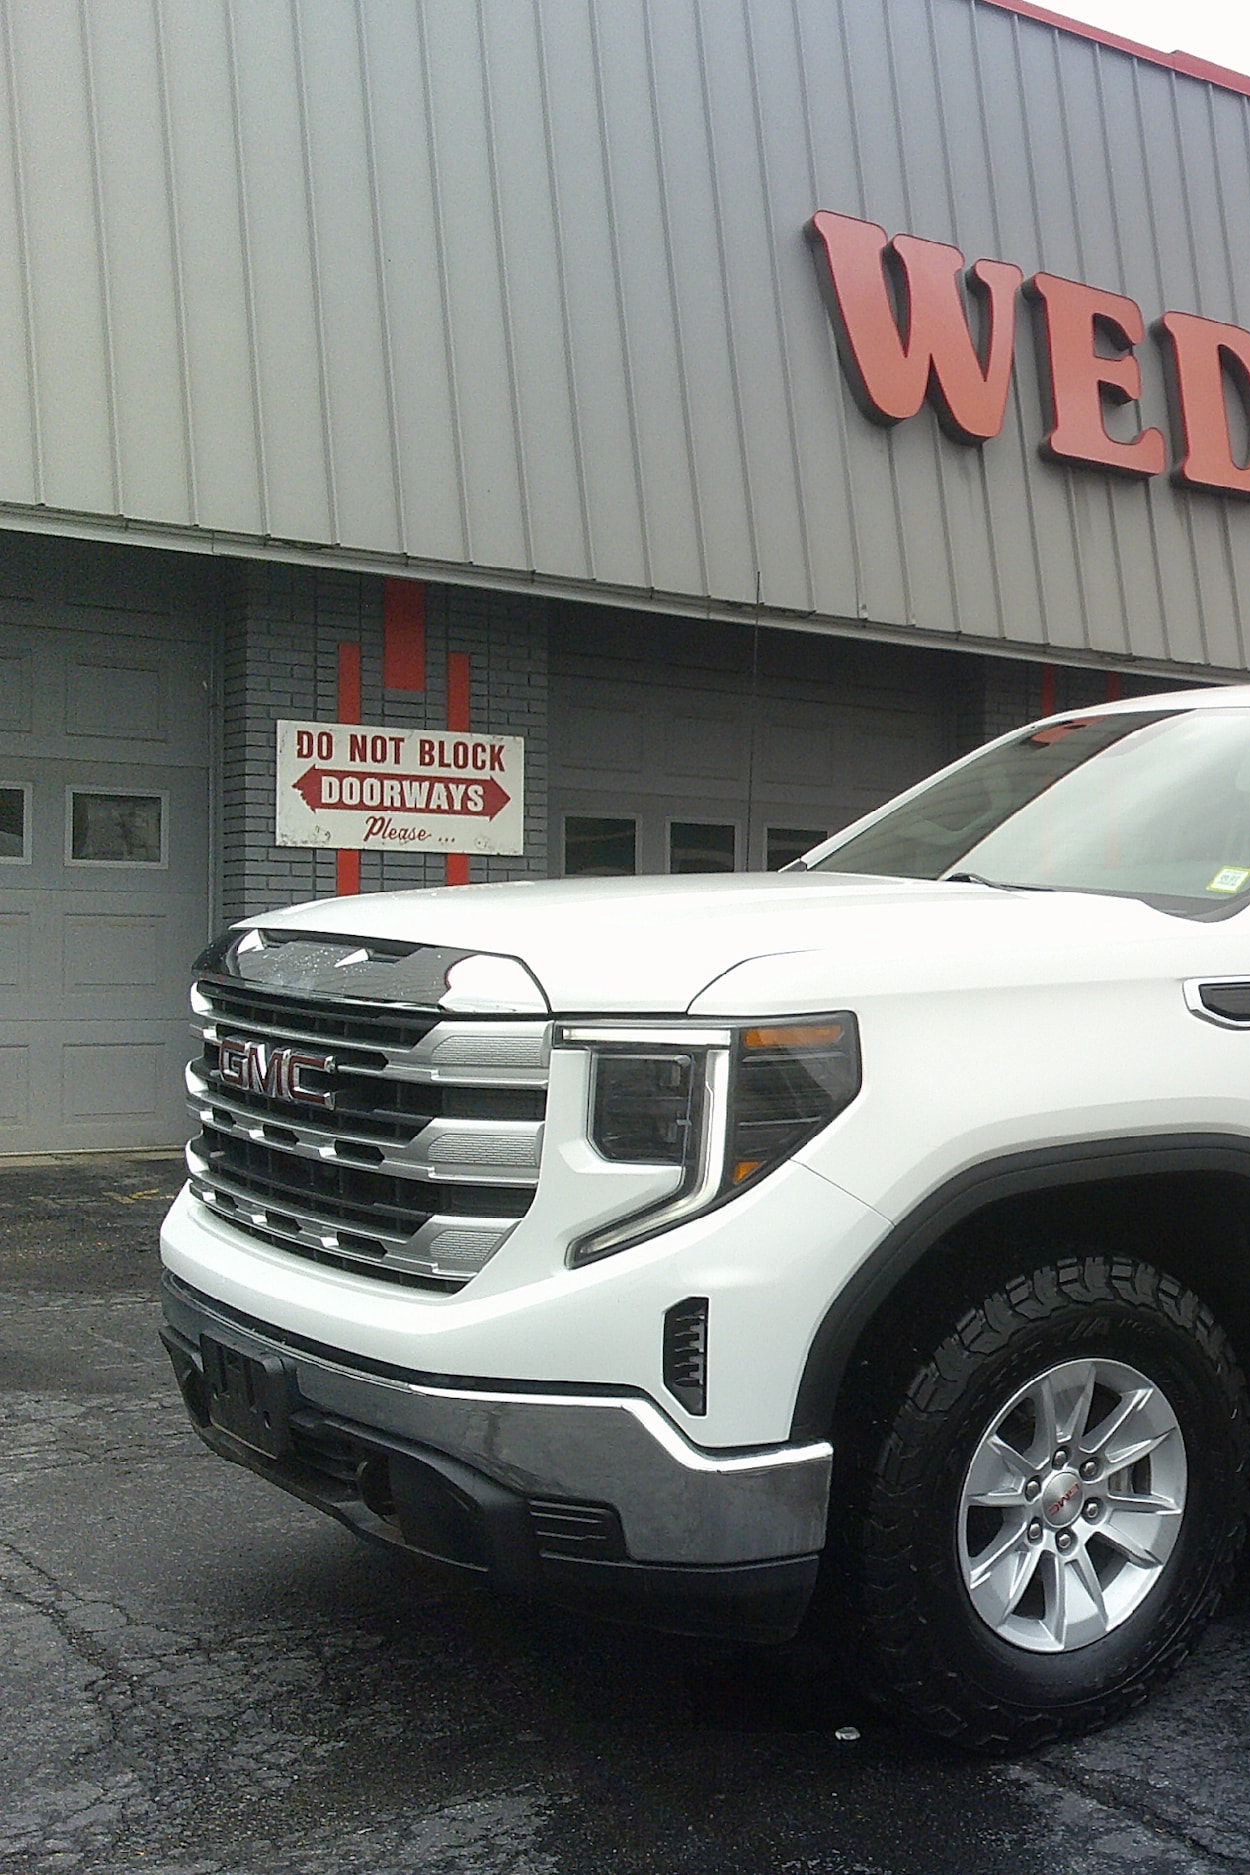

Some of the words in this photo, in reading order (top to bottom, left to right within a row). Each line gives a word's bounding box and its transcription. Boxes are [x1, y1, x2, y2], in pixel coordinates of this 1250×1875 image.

[296, 730, 333, 760] DO
[350, 734, 405, 765] NOT
[419, 739, 505, 772] BLOCK
[321, 776, 484, 812] DOORWAYS
[363, 816, 432, 842] Please
[219, 1038, 336, 1111] GMC
